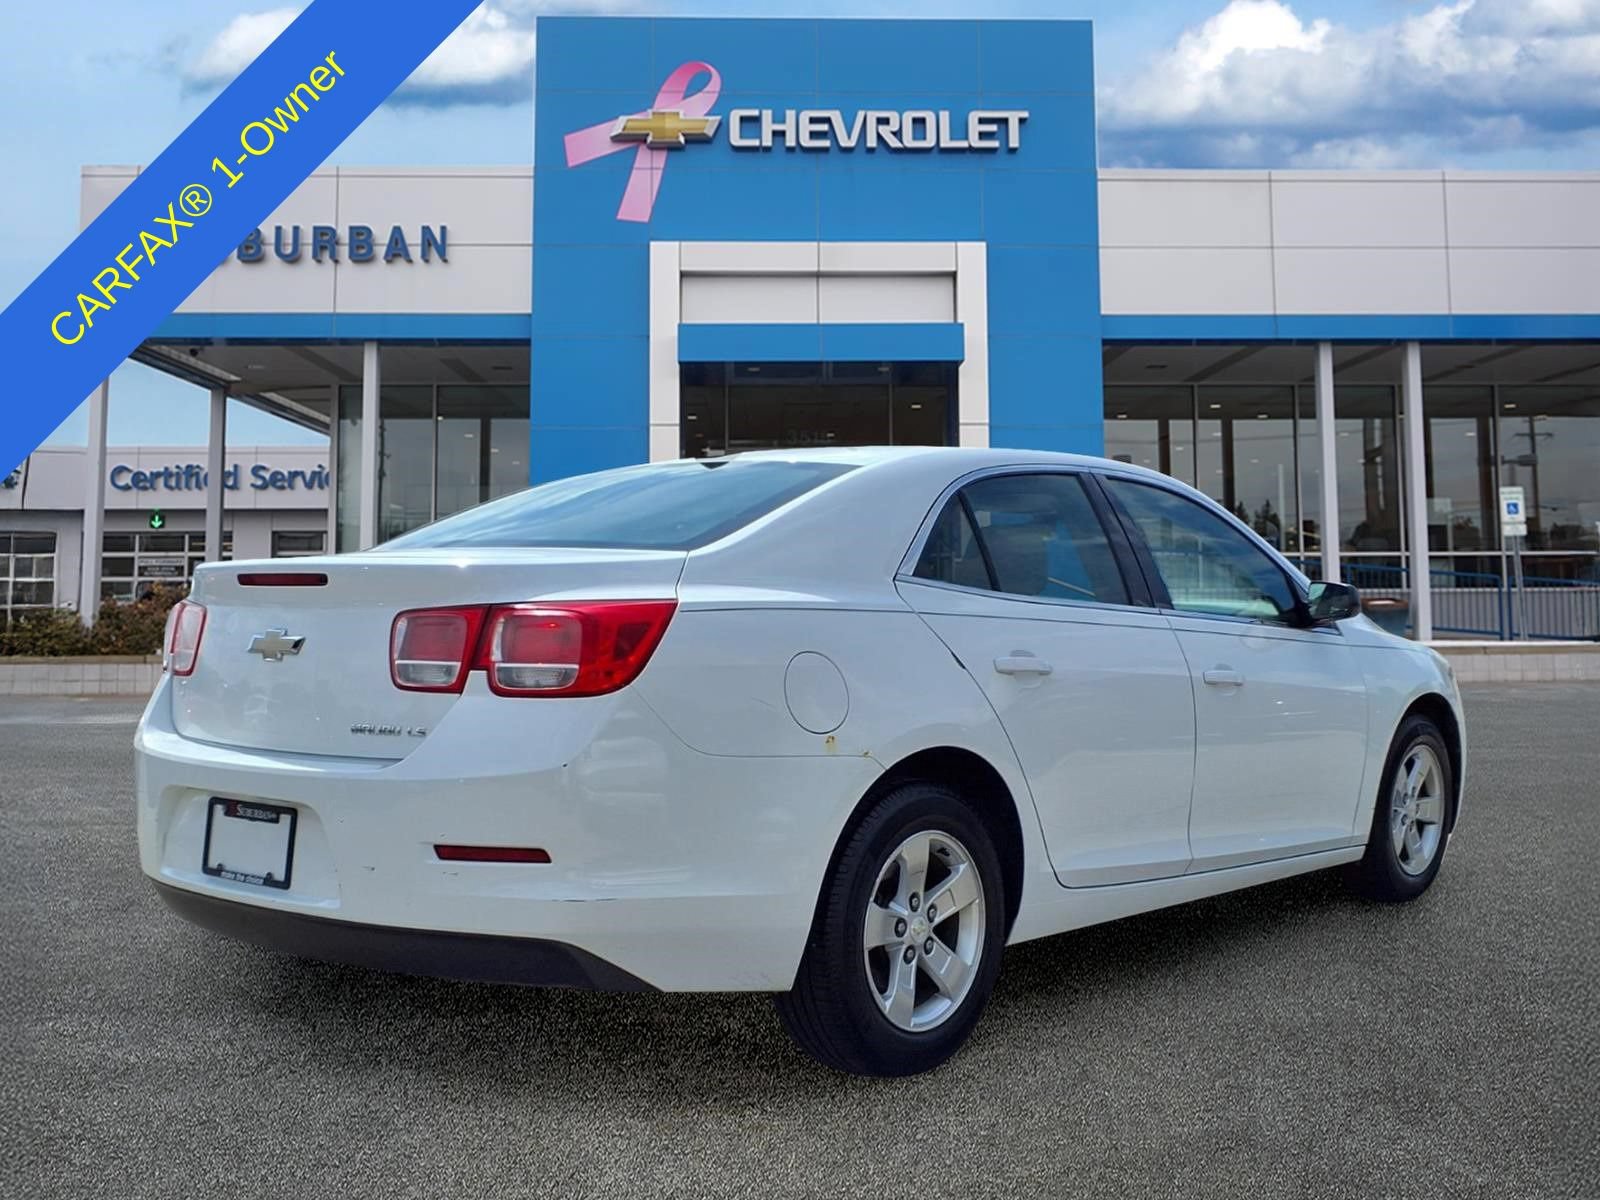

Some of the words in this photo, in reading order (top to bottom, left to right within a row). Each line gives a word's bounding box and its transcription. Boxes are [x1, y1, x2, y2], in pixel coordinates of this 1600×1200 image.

[729, 109, 1030, 150] CHEVROLET
[219, 225, 448, 264] BURBAN
[110, 464, 240, 491] Certifid
